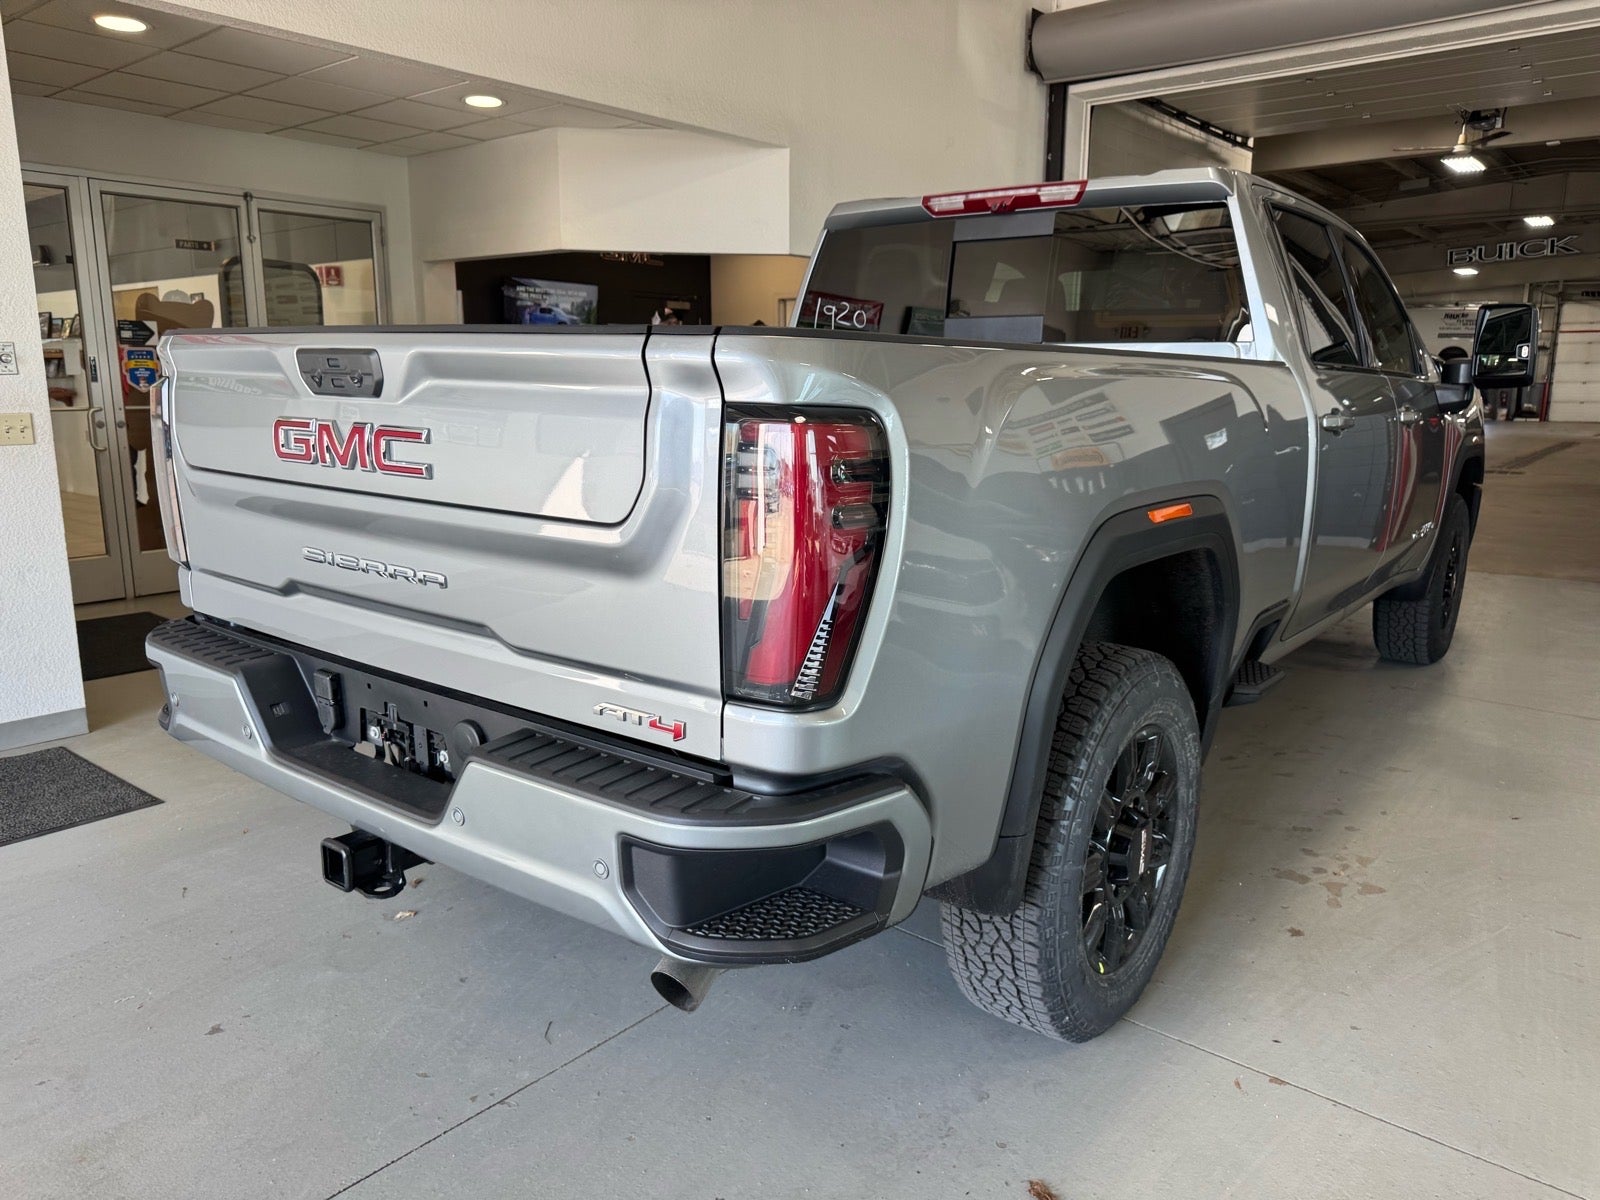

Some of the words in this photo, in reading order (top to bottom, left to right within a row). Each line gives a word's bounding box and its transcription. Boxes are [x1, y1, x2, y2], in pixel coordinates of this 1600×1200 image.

[1446, 235, 1580, 266] BUICK
[814, 297, 867, 330] 1920
[273, 416, 433, 480] GMC
[302, 545, 448, 589] SIERRA
[592, 701, 687, 742] AT4
